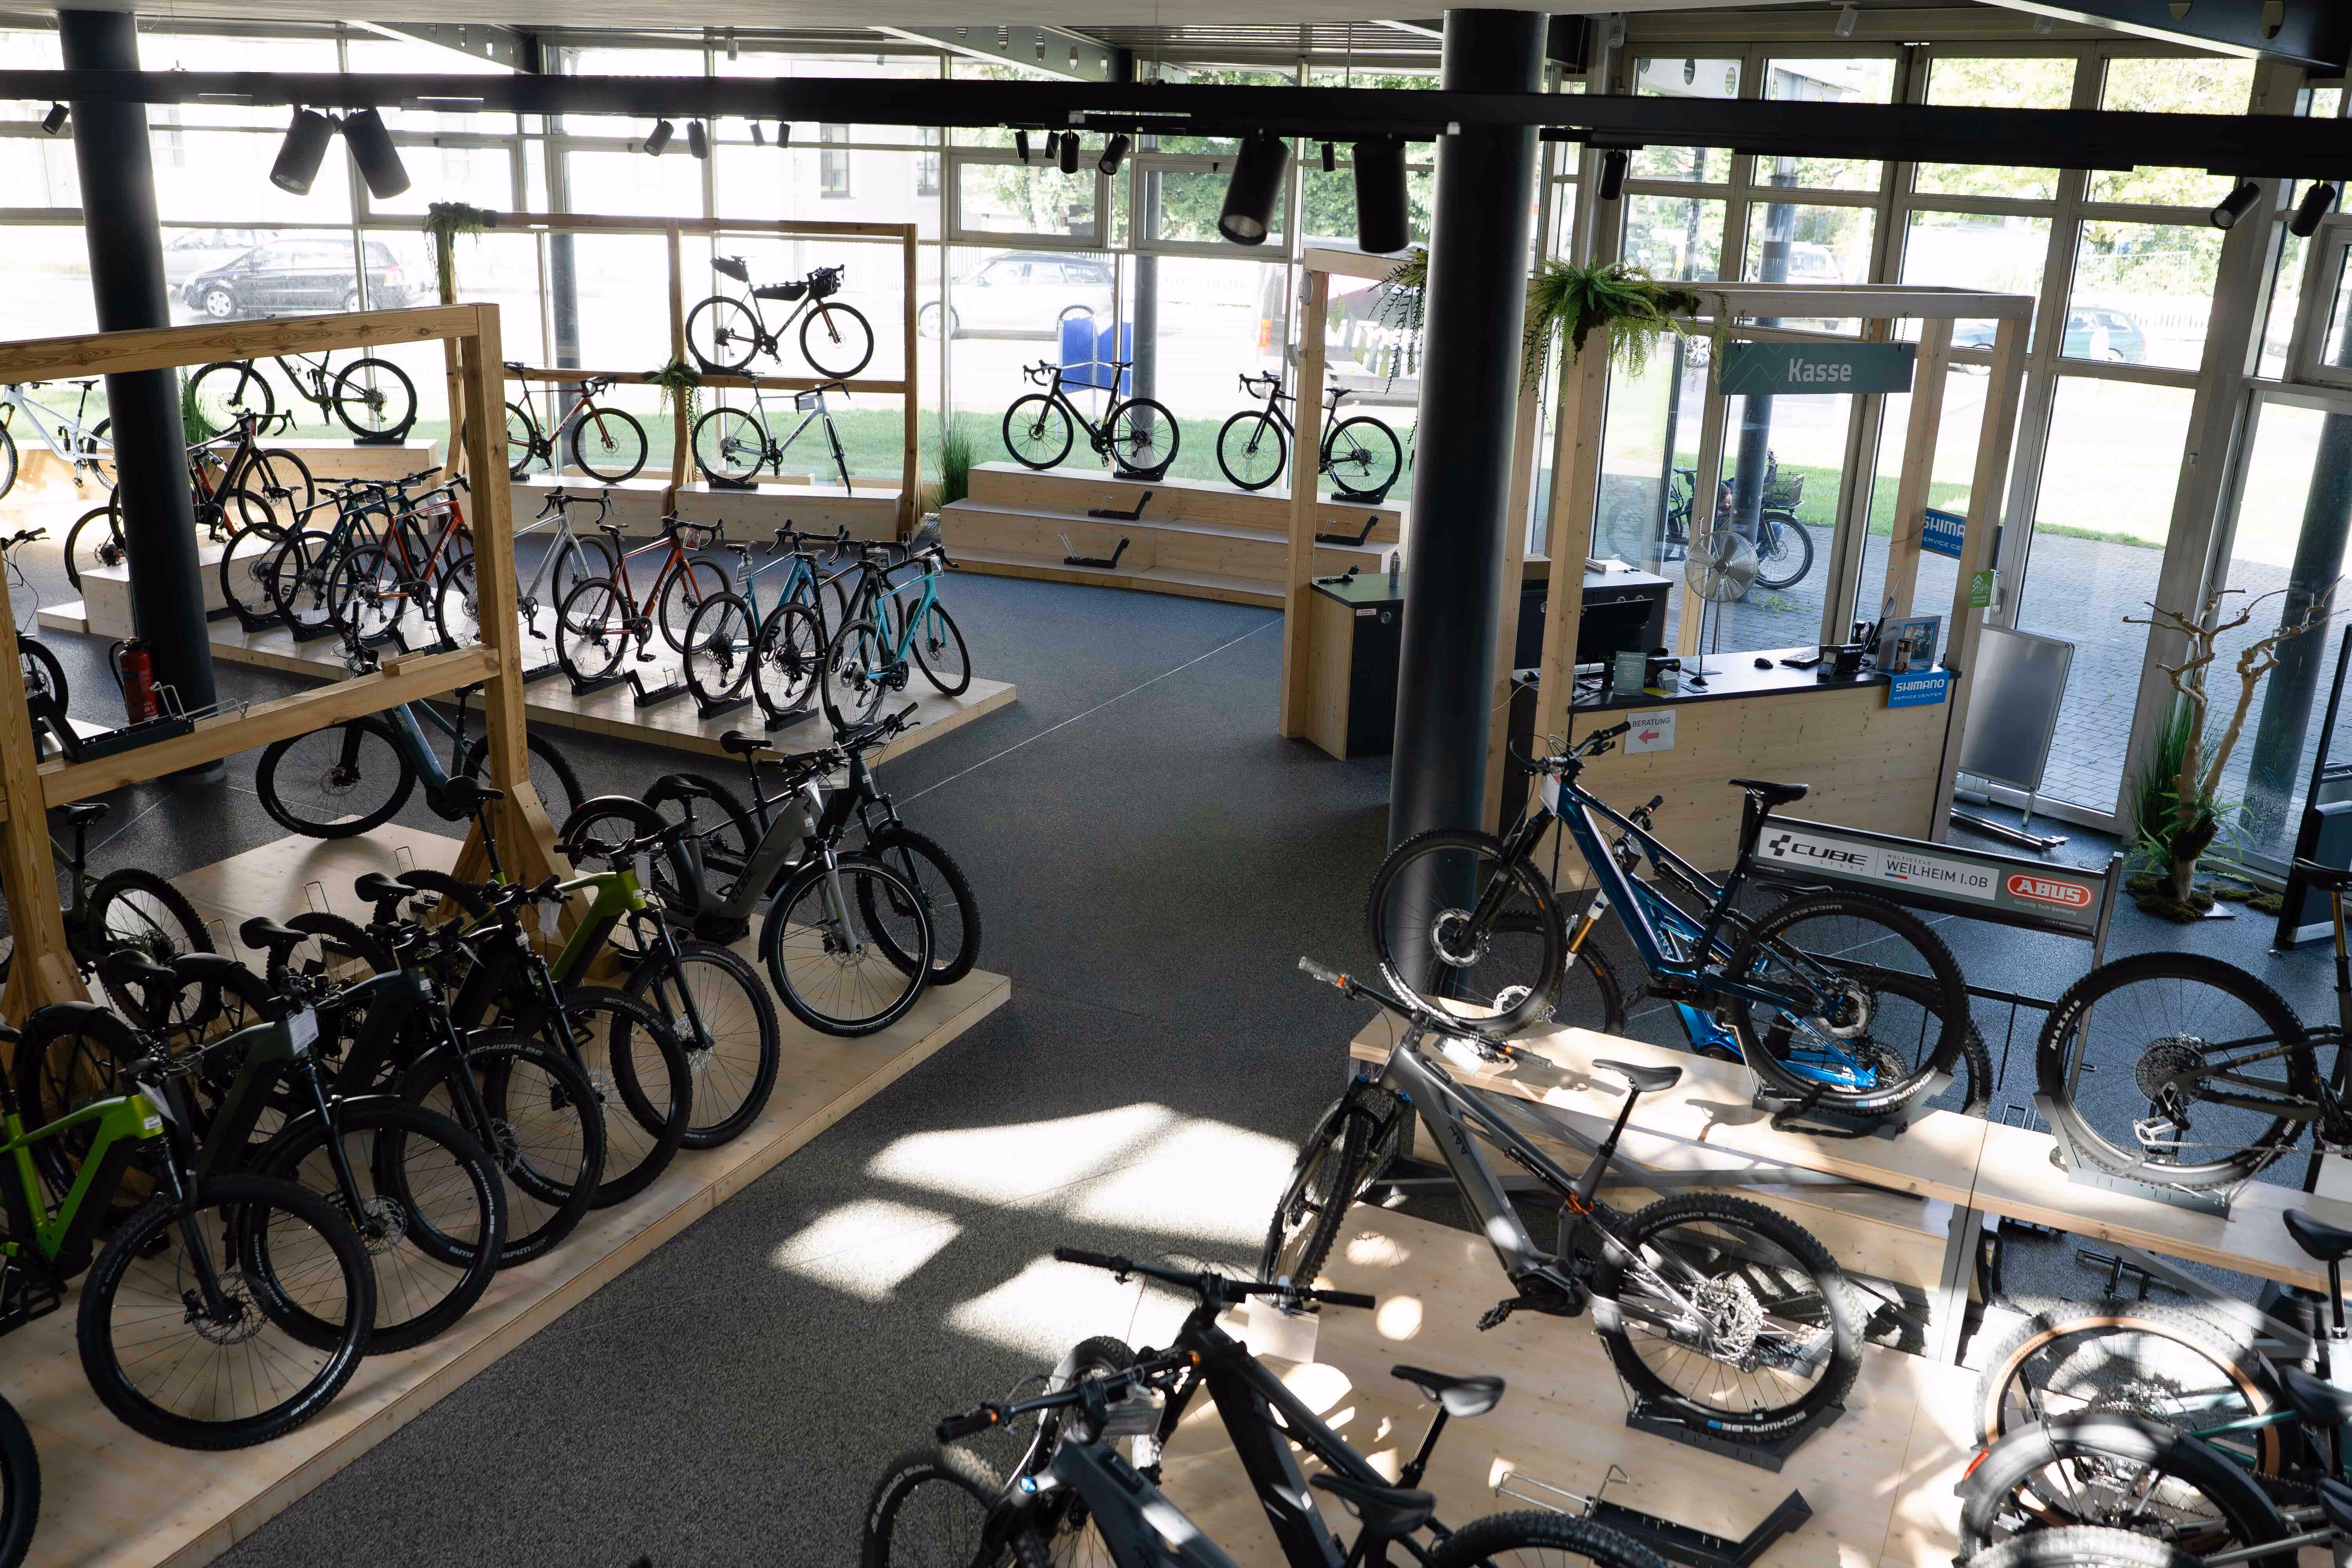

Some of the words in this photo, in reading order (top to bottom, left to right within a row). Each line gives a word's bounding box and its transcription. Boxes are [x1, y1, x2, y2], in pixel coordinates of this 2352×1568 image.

[1788, 358, 1852, 382] Kasse
[1924, 516, 1965, 538] SHIMA
[1922, 536, 1949, 548] ERVICE
[1895, 679, 1944, 692] SHIMANO
[394, 710, 411, 734] UBE
[1632, 717, 1670, 727] BERATUNG
[1791, 844, 1868, 866] CUBE
[1820, 860, 1863, 872] STORE
[1887, 853, 1931, 866] MULTICYCLE
[1887, 860, 1956, 882] WEILHEIM
[1961, 875, 1988, 888] I.OB
[2017, 880, 2081, 902] ABUS
[1790, 903, 1842, 918] WICKED
[2013, 899, 2036, 909] Security
[2038, 902, 2050, 911] Tech
[2051, 905, 2077, 916] Germany
[699, 949, 750, 977] SCHWALBE
[603, 997, 666, 1033] SCHWALBE
[2050, 1000, 2082, 1051] MAXXIS
[469, 1044, 544, 1056] SCHWALBE
[1868, 1065, 1938, 1107] SCHWALBE
[518, 1163, 551, 1190] MART
[1721, 1409, 1807, 1434] SCHWALBE
